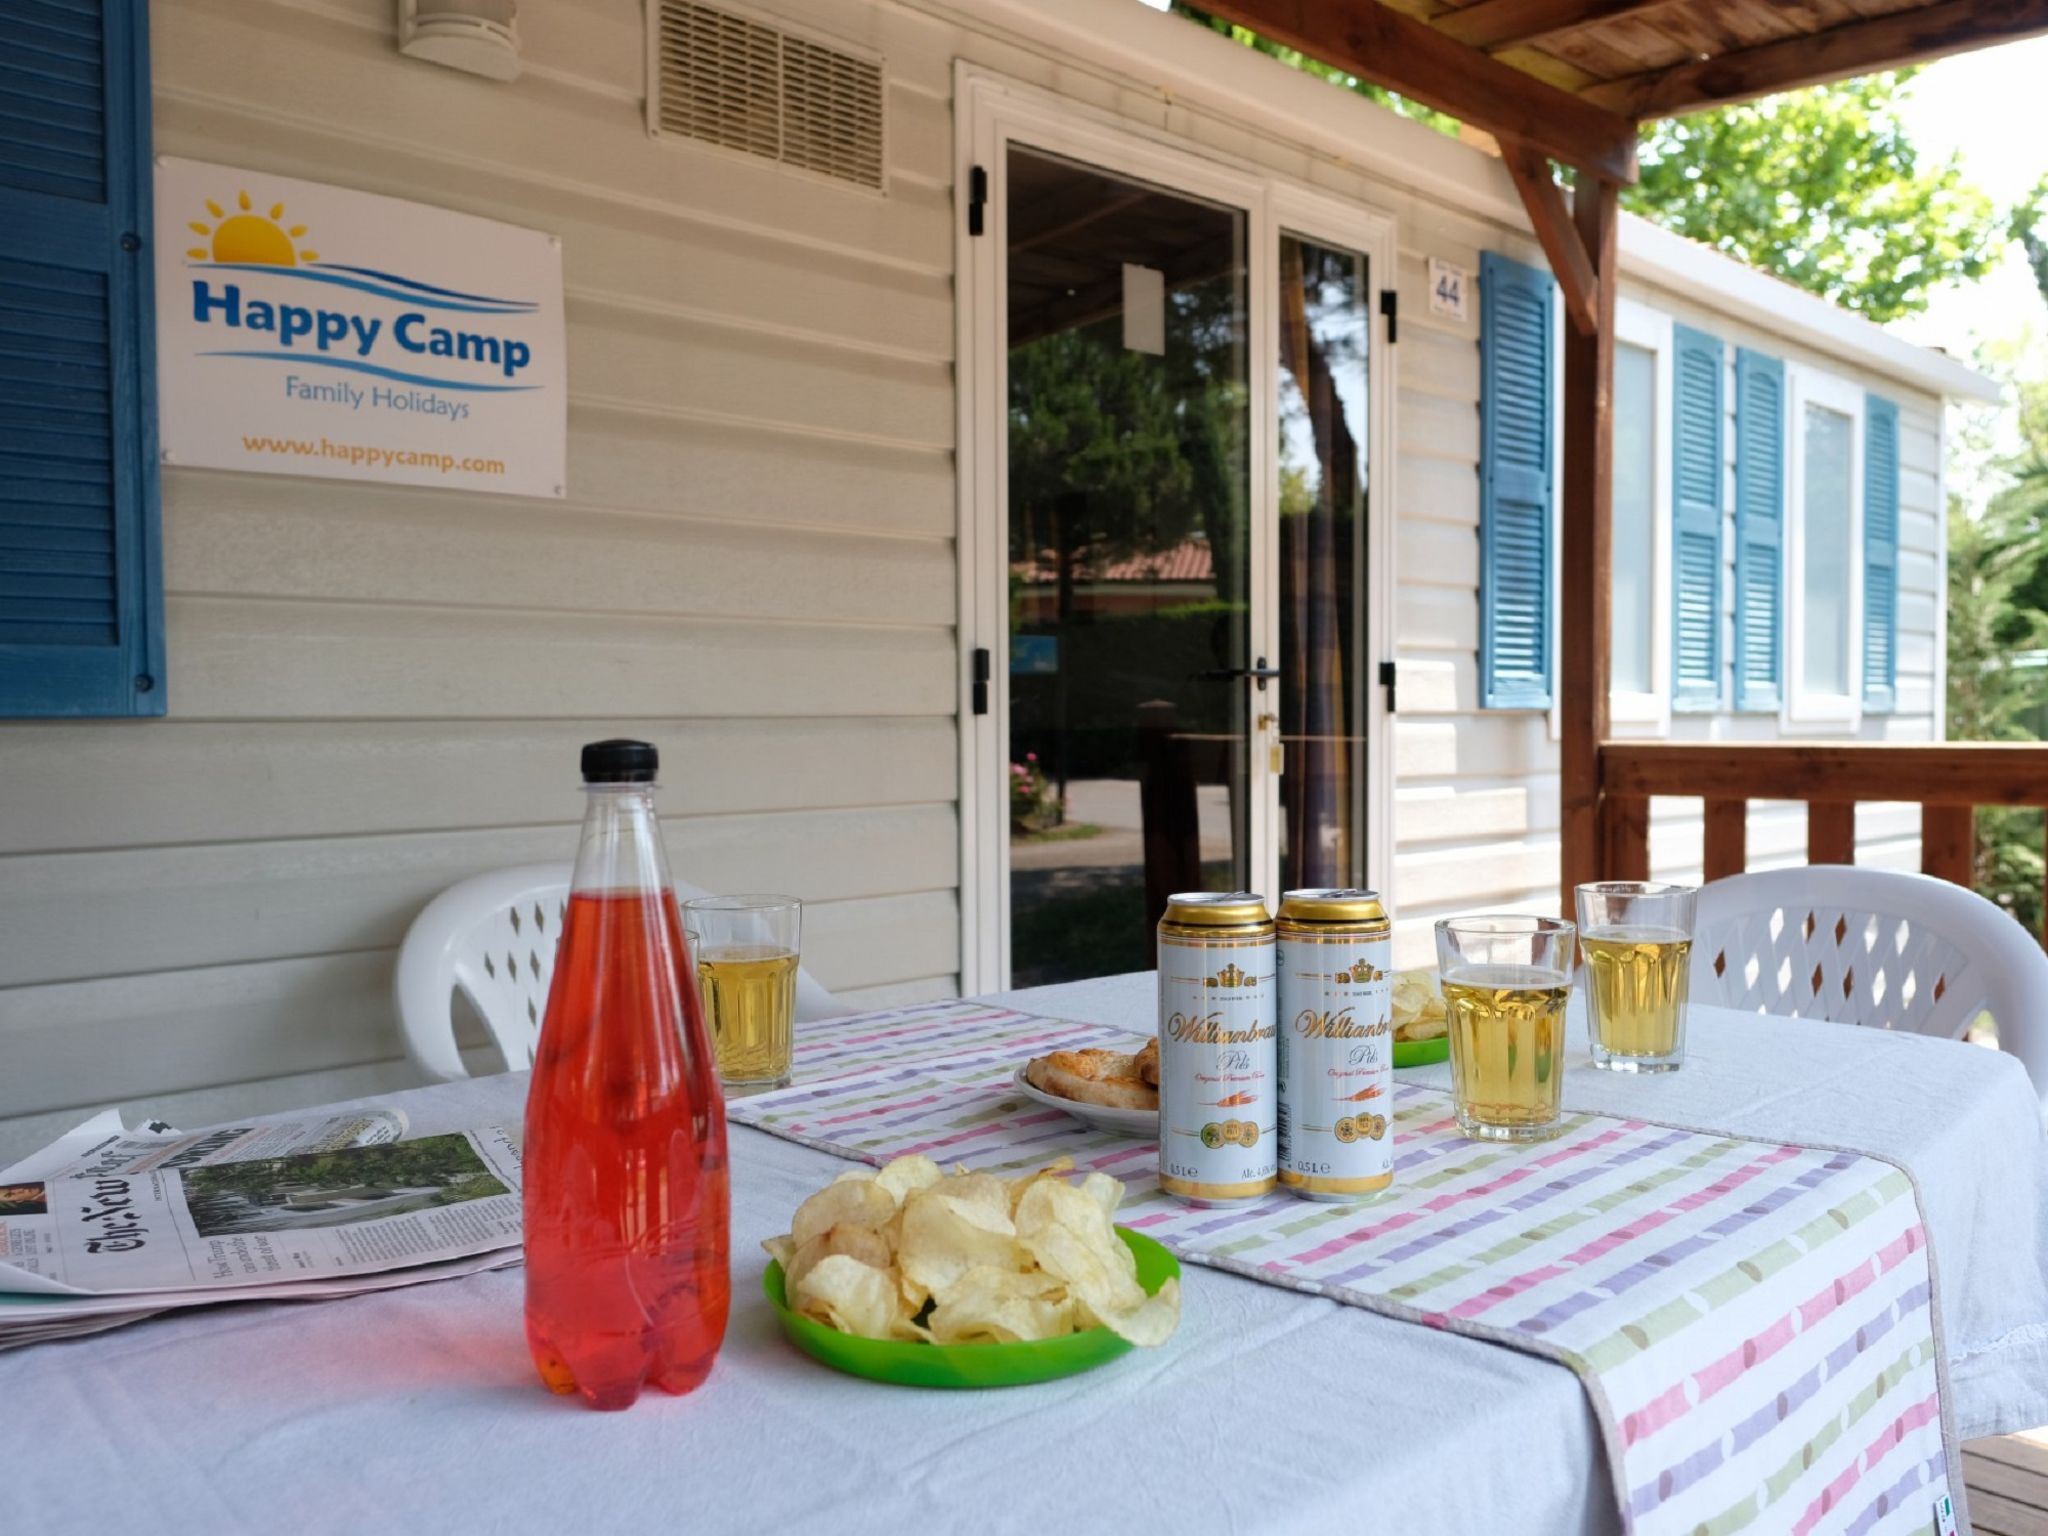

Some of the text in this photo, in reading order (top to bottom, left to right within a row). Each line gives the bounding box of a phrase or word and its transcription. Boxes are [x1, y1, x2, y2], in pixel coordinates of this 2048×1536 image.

[1435, 274, 1460, 307] 44
[192, 280, 531, 377] Happy Camp
[286, 375, 470, 421] Family Holidays
[242, 434, 506, 474] www.happycamp.com
[1216, 1050, 1250, 1070] Pils
[1348, 1044, 1378, 1066] Pils
[80, 1179, 142, 1222] New
[84, 1222, 149, 1253] The
[207, 1240, 226, 1264] Trump
